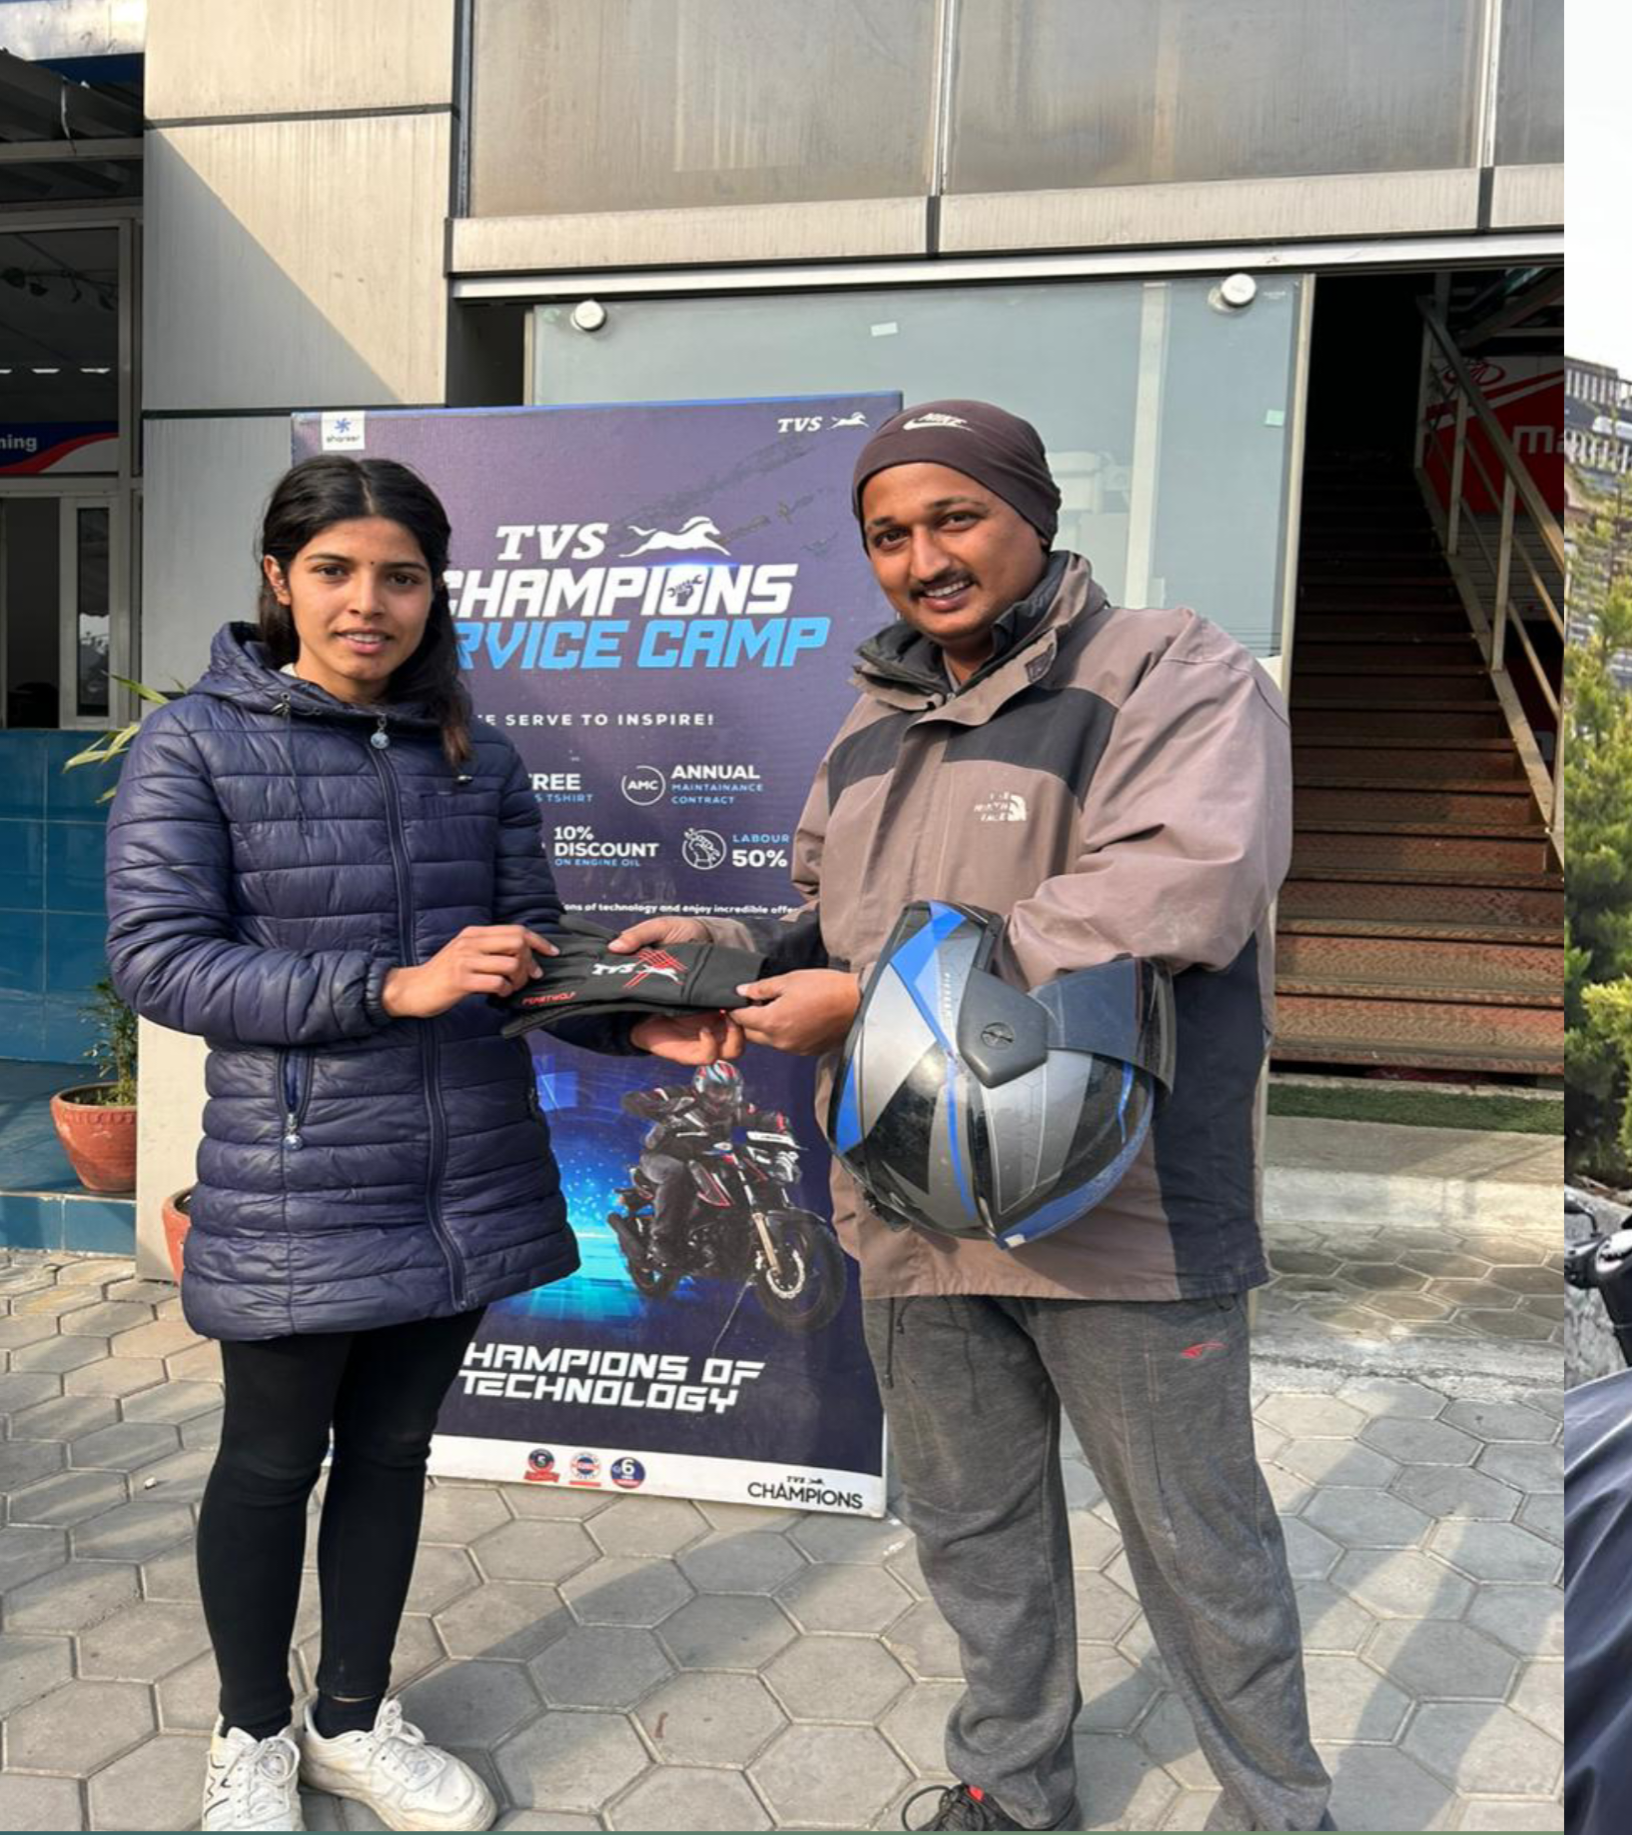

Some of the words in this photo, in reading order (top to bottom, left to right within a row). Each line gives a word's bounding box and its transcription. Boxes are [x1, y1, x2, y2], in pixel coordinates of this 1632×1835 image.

[777, 416, 823, 433] TVS
[0, 433, 37, 452] ning
[495, 522, 609, 561] TVS
[442, 563, 798, 618] CHAMPIONS
[454, 619, 630, 670] RVICE
[637, 617, 831, 668] CAMP
[505, 714, 573, 726] SERVE
[581, 714, 609, 726] TO
[617, 713, 715, 726] INSPIRE!
[671, 765, 760, 779] ANNUAL
[528, 773, 581, 791] REE
[627, 780, 659, 790] AMC
[671, 783, 763, 792] MAINTAINANCE
[546, 793, 593, 803] TSHIRT
[671, 796, 735, 805] CONTRACT
[554, 826, 594, 840] 10%
[732, 834, 790, 844] LABOUR
[554, 842, 659, 857] DISCOUNT
[732, 849, 788, 868] 50%
[585, 903, 597, 911] of
[598, 903, 657, 914] technology
[660, 904, 680, 912] and
[463, 1342, 690, 1382] HAMPIONS
[701, 1357, 766, 1386] OF
[458, 1369, 739, 1414] TECHNOLOGY
[747, 1481, 864, 1510] CHAMPIONS
